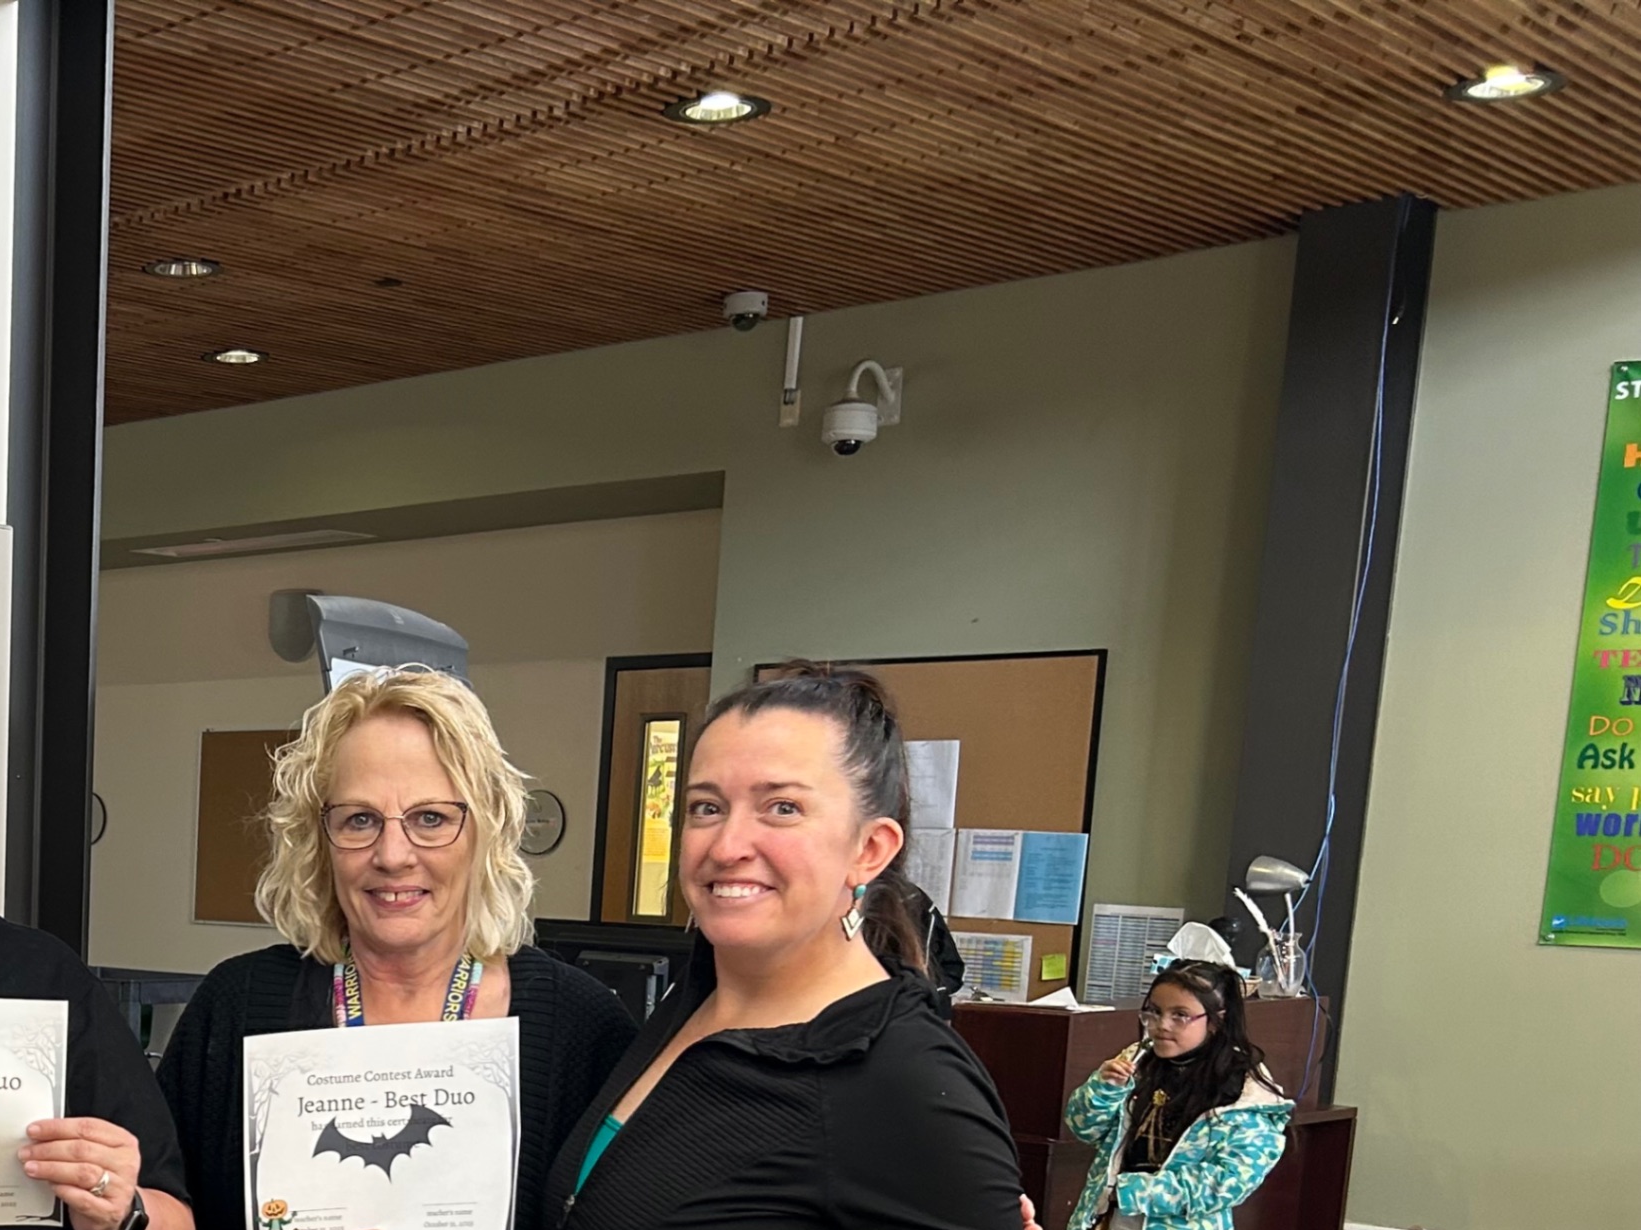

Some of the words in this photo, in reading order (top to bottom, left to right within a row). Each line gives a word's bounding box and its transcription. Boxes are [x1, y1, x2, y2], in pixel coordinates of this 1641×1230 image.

[1589, 715, 1634, 737] DO
[1577, 742, 1635, 770] Ask
[1571, 786, 1621, 811] say
[1575, 812, 1641, 838] wor
[344, 957, 363, 1020] WARRIO
[443, 951, 472, 1021] WARRIORS
[307, 1074, 361, 1086] Costume
[364, 1070, 412, 1083] Contest
[414, 1065, 454, 1079] Award
[297, 1096, 365, 1117] Jeanne
[385, 1091, 427, 1108] Best
[434, 1088, 475, 1106] Duo
[337, 1118, 364, 1129] arned
[366, 1117, 385, 1127] this
